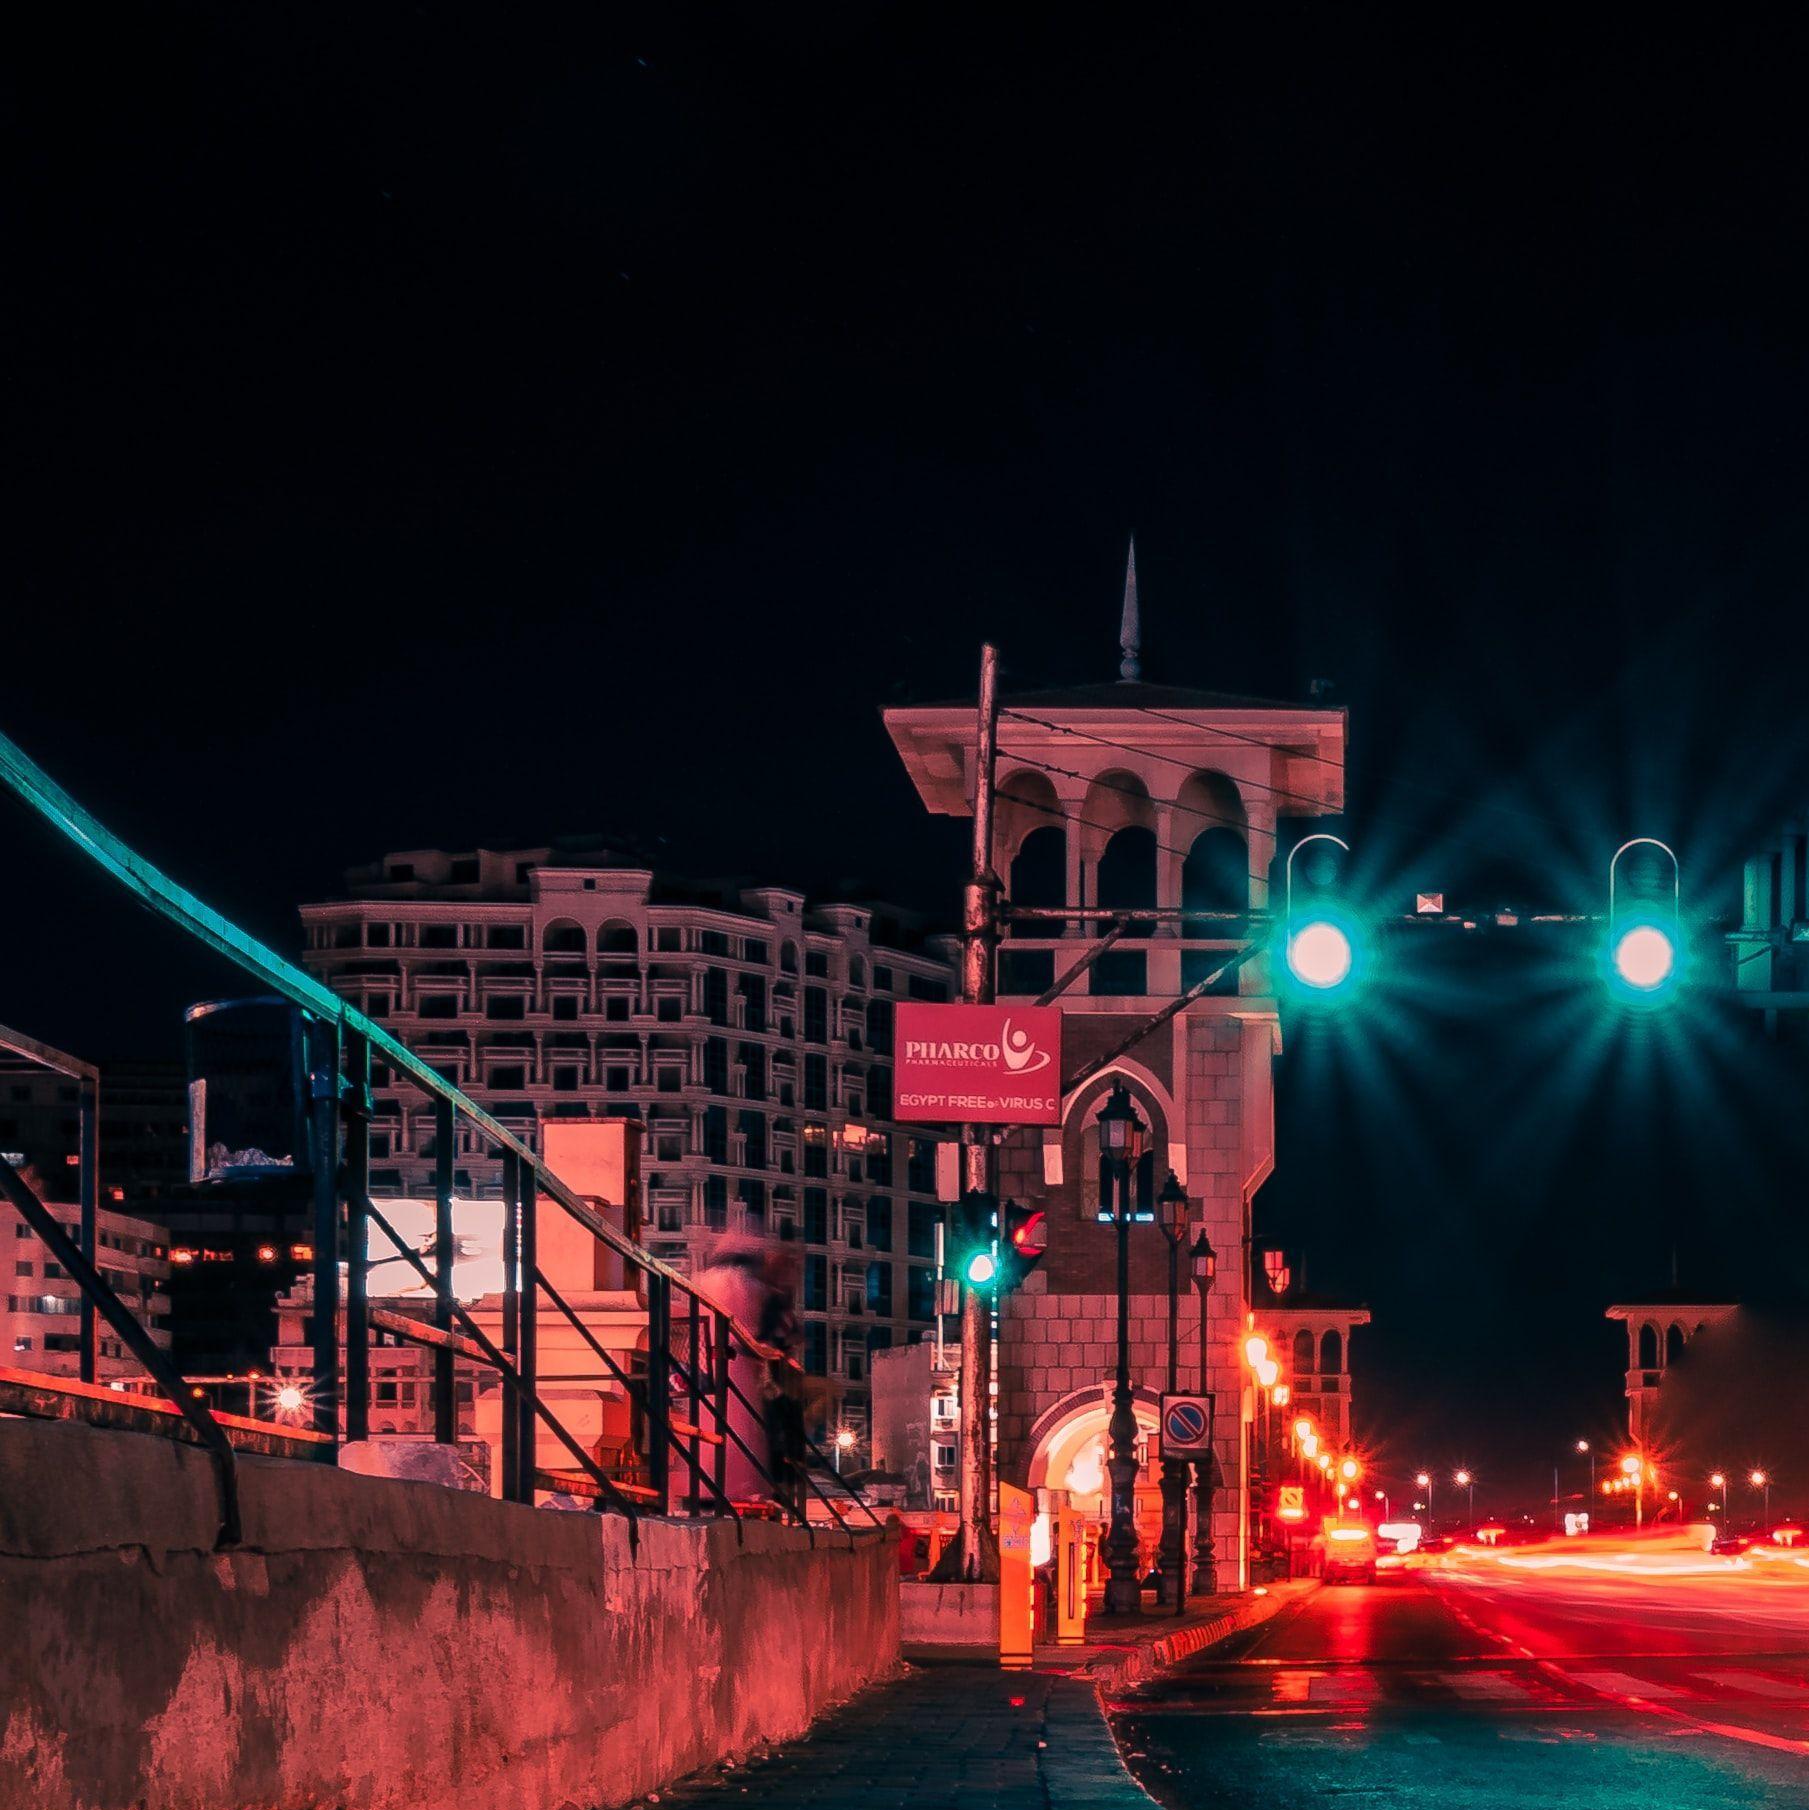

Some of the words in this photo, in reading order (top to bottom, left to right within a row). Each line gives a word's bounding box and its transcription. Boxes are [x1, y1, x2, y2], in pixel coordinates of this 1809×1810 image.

[905, 1041, 1000, 1060] PHARCO
[900, 1094, 946, 1107] EGYPT
[948, 1095, 986, 1109] FREE
[1000, 1096, 1043, 1110] VIRUS
[1045, 1098, 1055, 1110] C
